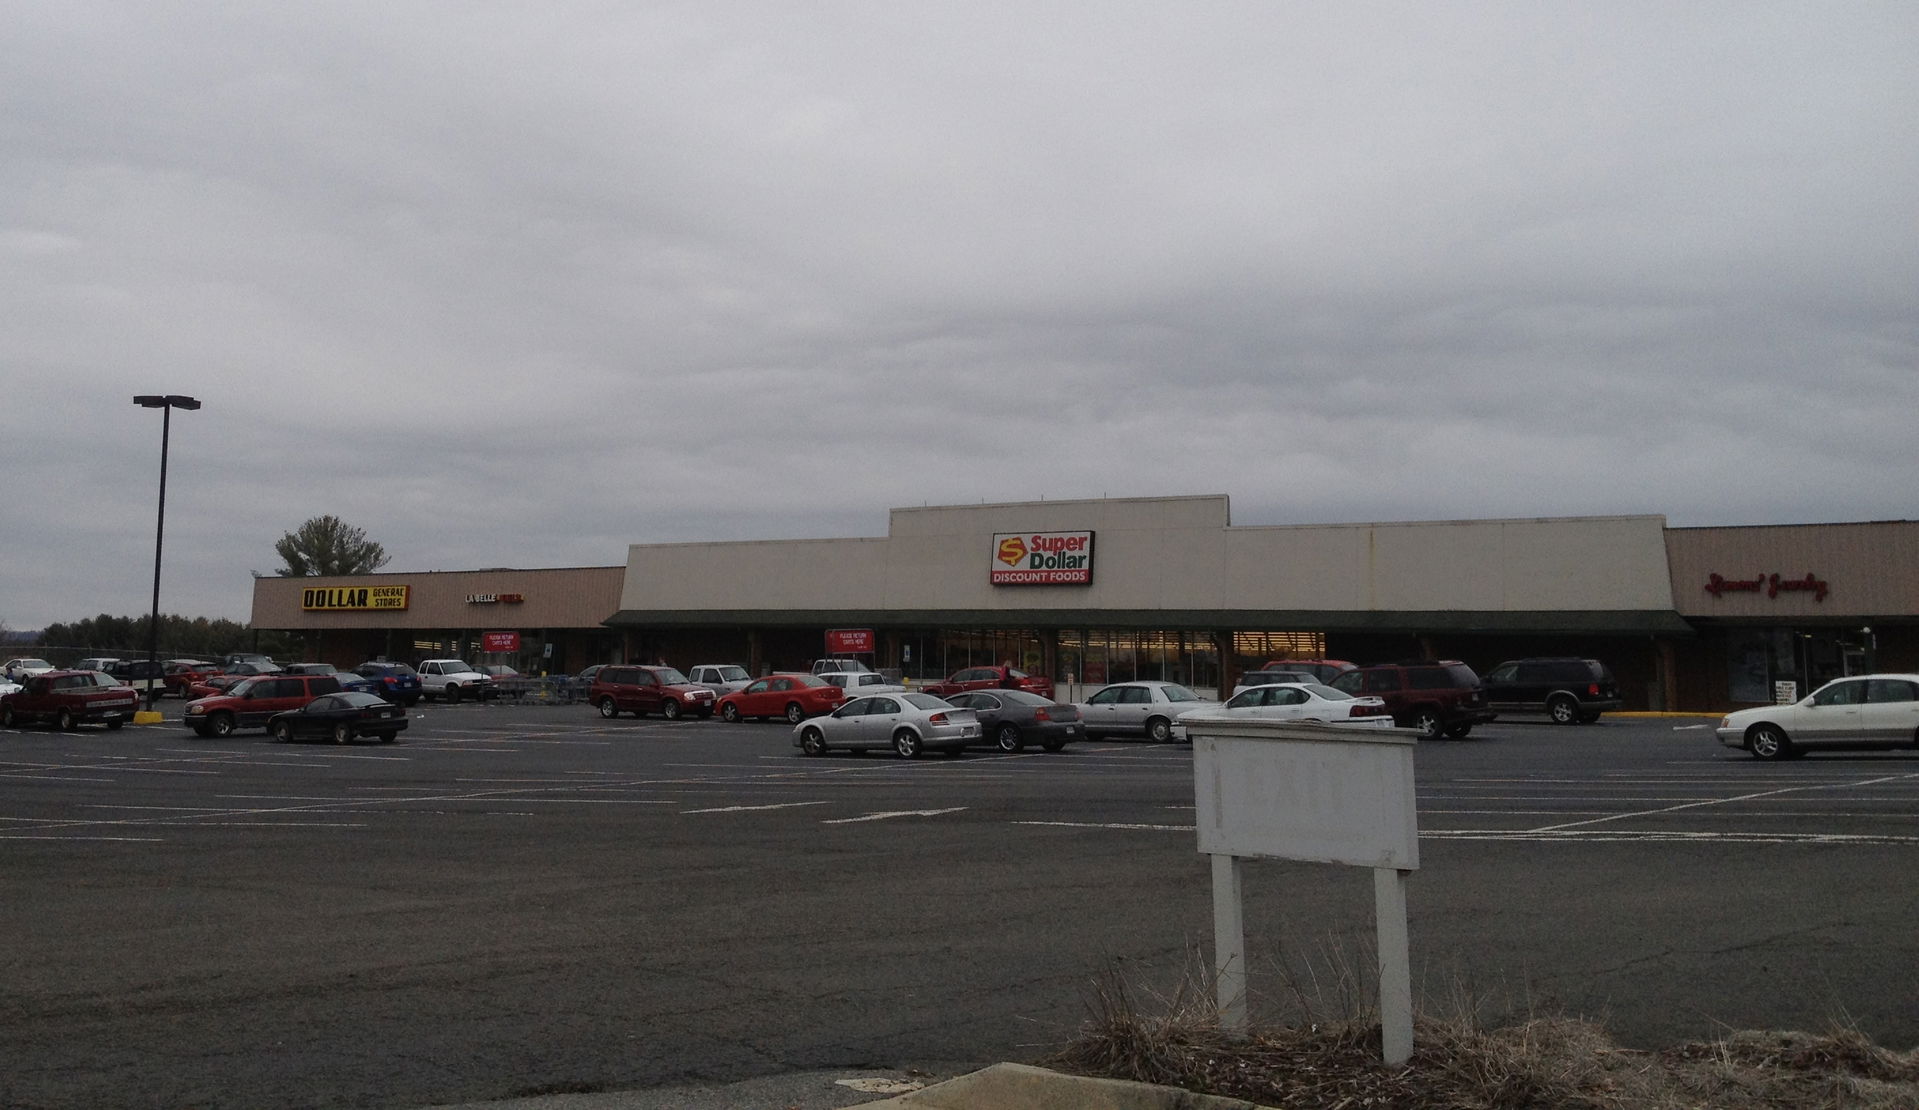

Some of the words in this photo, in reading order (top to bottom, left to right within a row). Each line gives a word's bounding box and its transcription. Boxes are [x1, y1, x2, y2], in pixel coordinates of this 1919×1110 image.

[1031, 535, 1087, 556] Super
[1030, 551, 1086, 569] Dollar
[993, 573, 1047, 582] DISCOUNT
[1050, 571, 1086, 581] FOODS
[304, 588, 368, 608] DOLLAR
[373, 587, 404, 597] GENERAL
[375, 598, 402, 607] STORES
